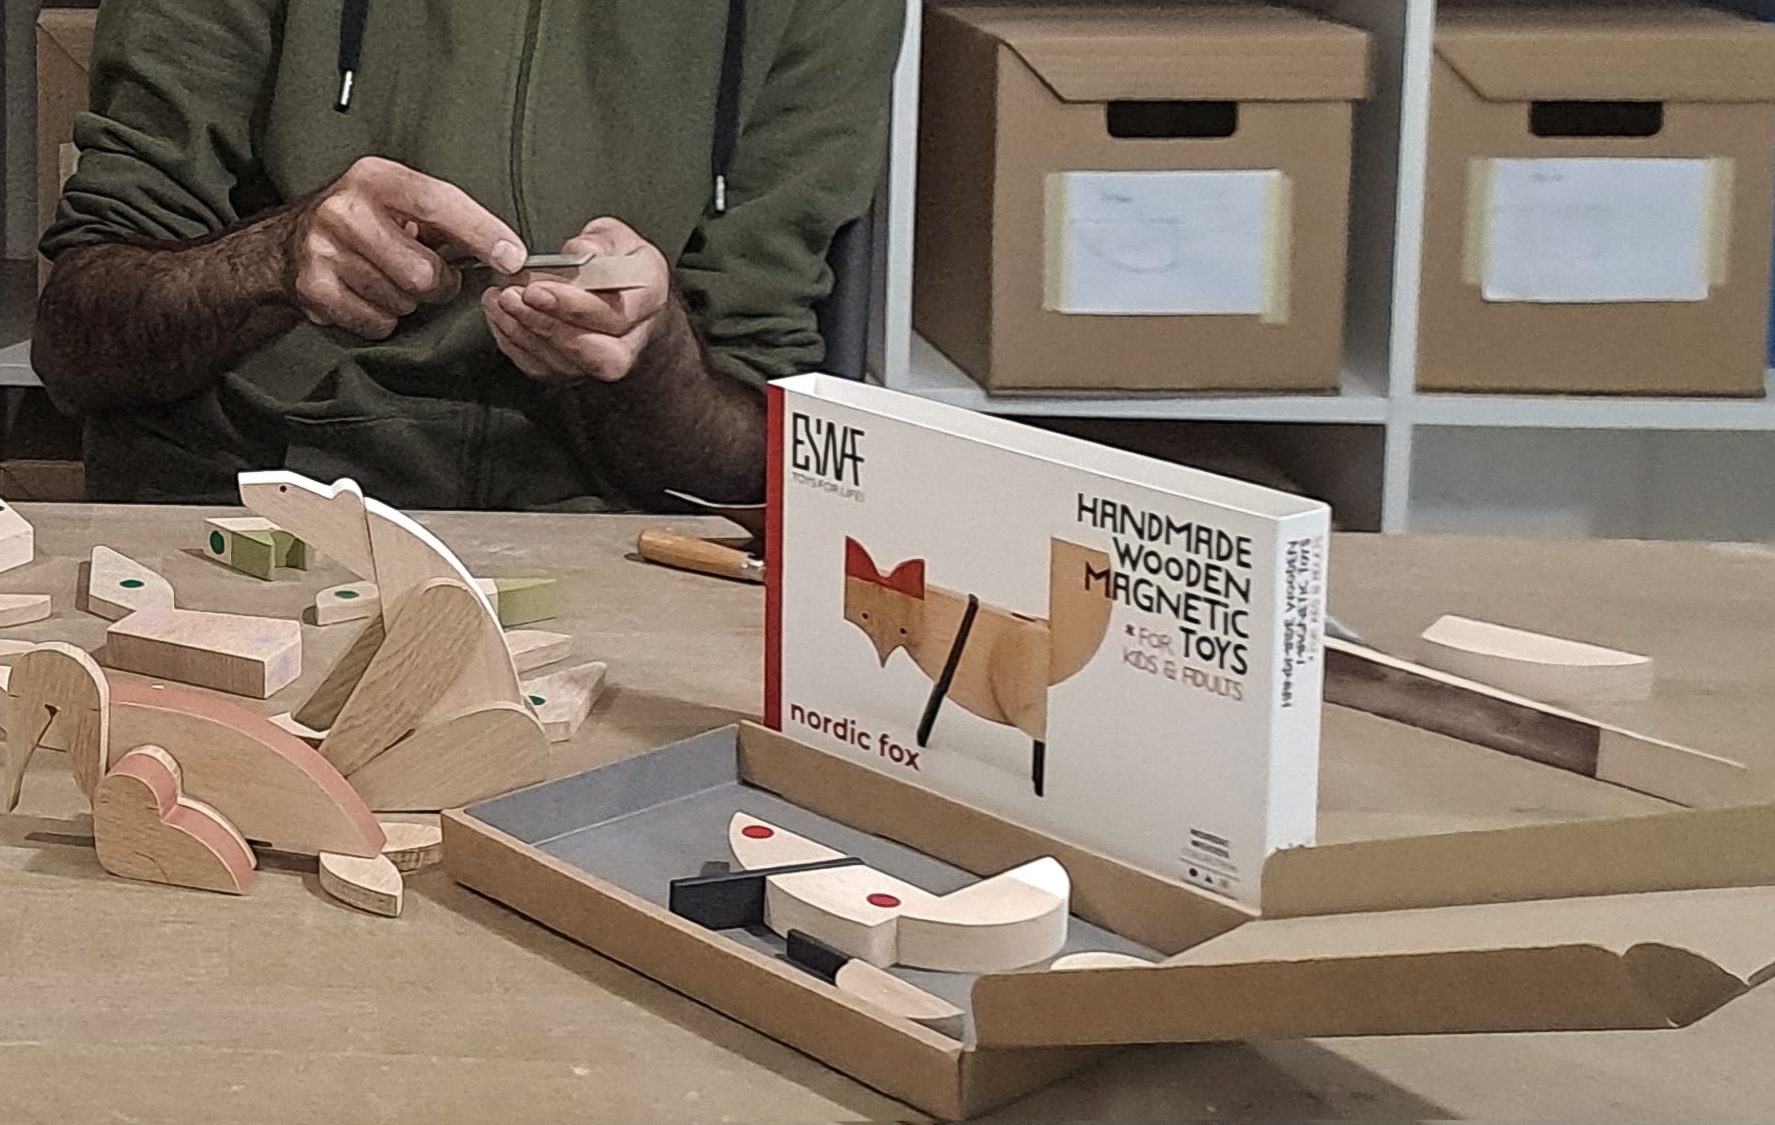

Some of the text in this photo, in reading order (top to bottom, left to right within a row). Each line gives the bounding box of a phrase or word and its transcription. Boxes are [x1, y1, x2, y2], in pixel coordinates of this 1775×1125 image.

[1077, 493, 1252, 568] HANDMADE
[1113, 537, 1251, 604] WOODEN
[1180, 626, 1248, 675] TOYS
[1182, 665, 1244, 702] ADULTS
[790, 703, 921, 772] nordic fox
